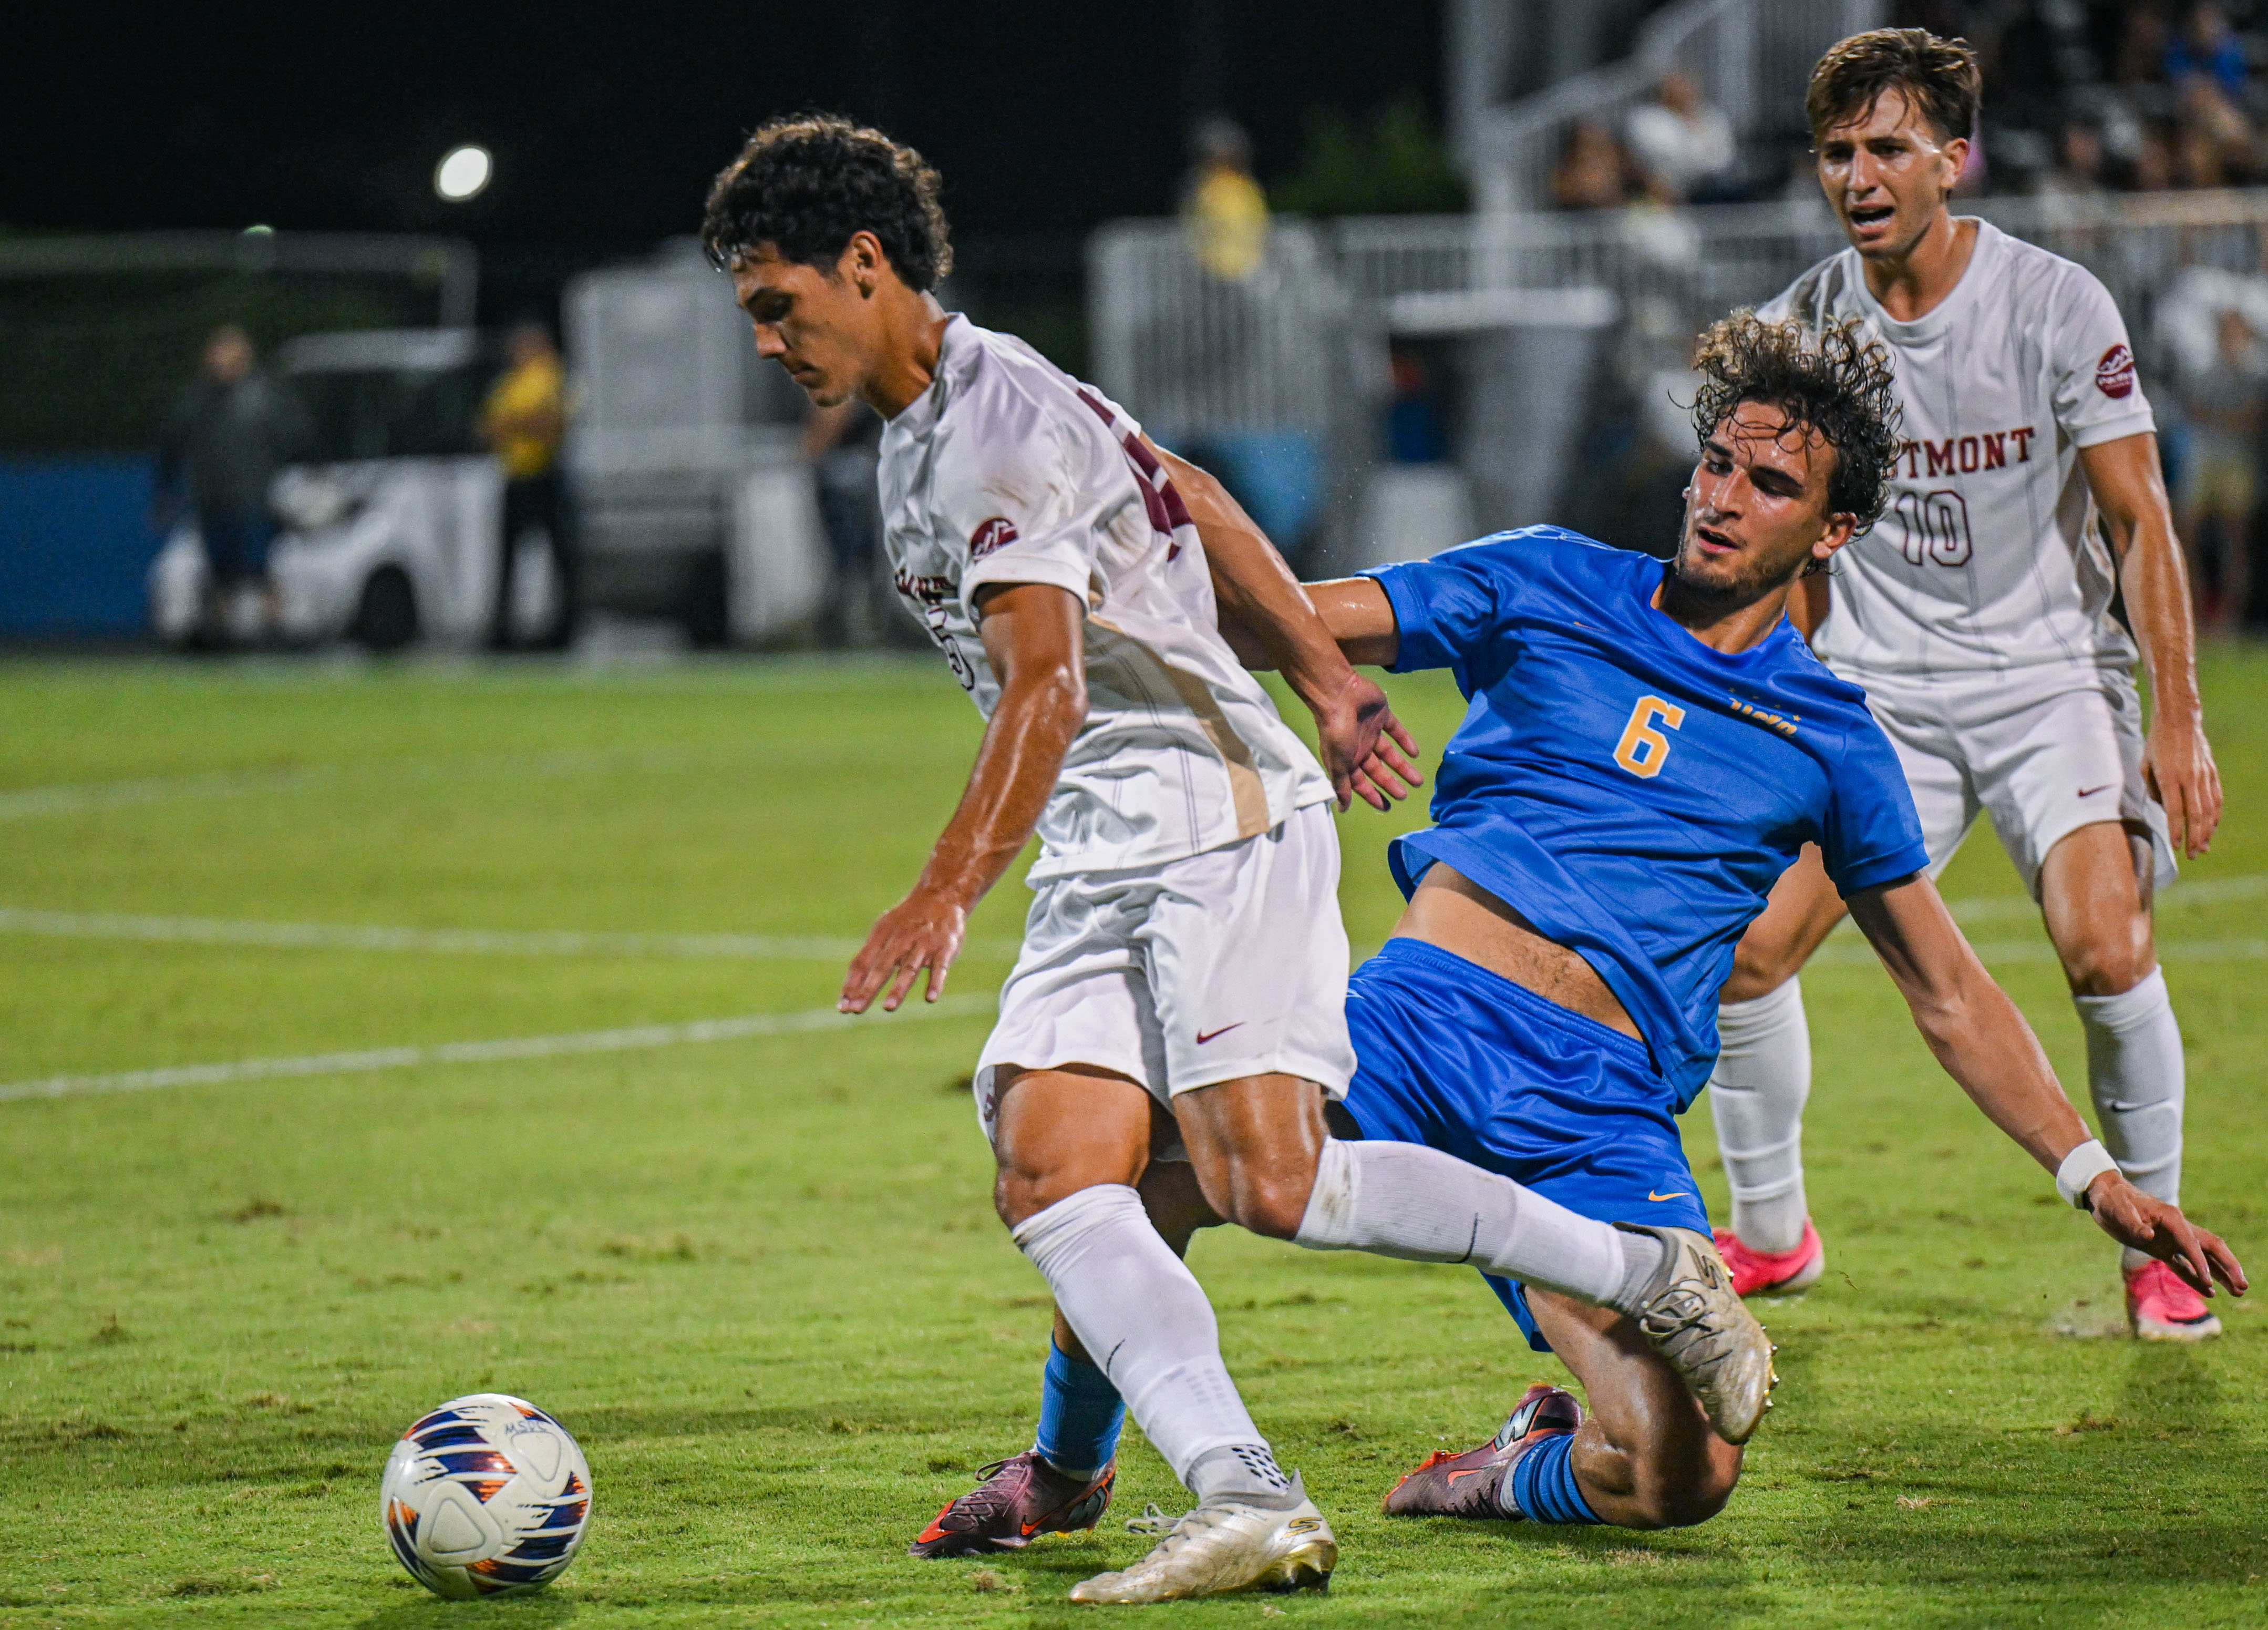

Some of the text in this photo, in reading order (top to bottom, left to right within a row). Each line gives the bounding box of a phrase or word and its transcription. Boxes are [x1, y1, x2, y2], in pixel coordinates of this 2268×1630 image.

[1884, 425, 2036, 480] TMONT
[1894, 489, 1973, 567] 10
[1612, 694, 1686, 780] 6
